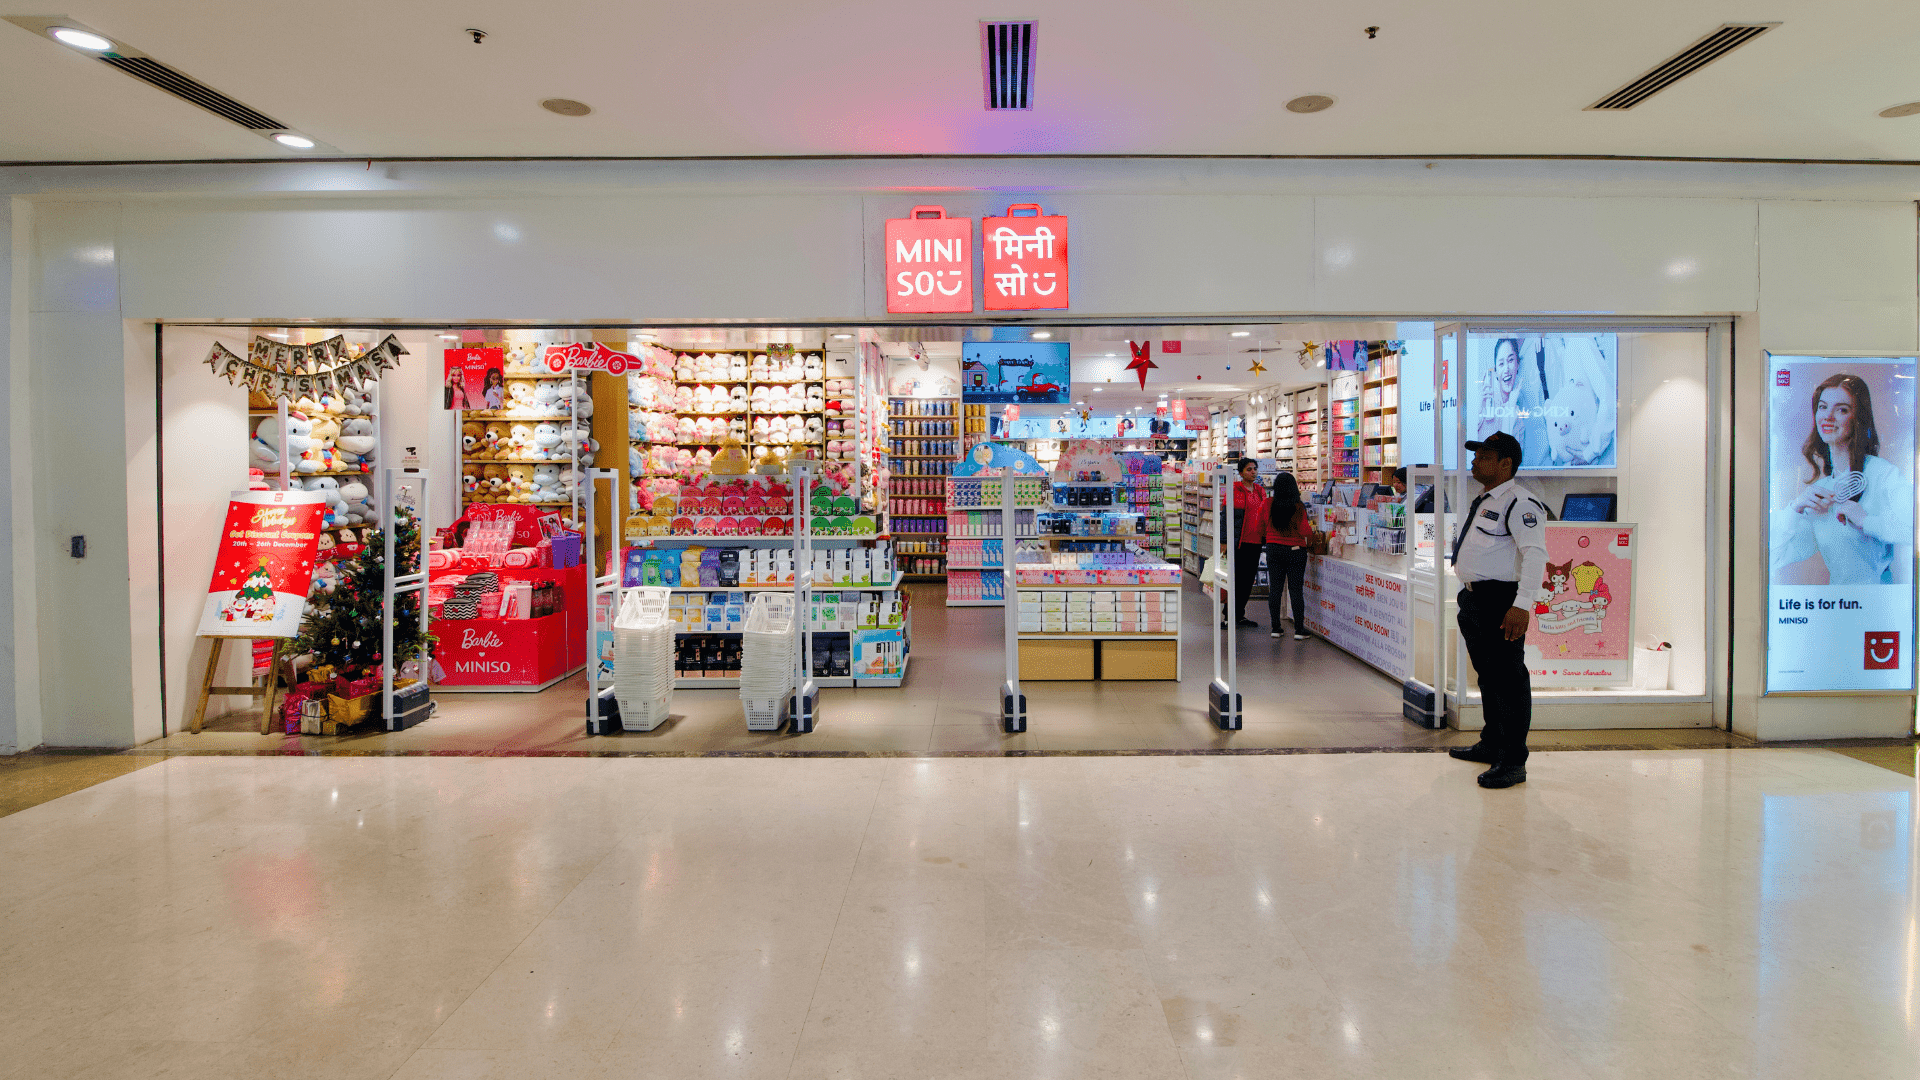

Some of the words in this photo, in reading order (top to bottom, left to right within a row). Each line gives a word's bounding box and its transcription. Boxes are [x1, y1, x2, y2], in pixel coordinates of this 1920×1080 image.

[896, 238, 962, 263] MINI
[992, 226, 1056, 260] मिनी
[993, 263, 1028, 297] सो
[255, 341, 342, 366] MERRY
[567, 343, 606, 368] Barbie
[226, 351, 385, 393] CHRISTMAS
[1419, 400, 1431, 412] Life
[494, 508, 524, 522] Barbie
[245, 530, 280, 539] Discount
[281, 531, 315, 541] Coupons
[1365, 574, 1374, 585] SEE
[1374, 577, 1385, 588] YOU
[1779, 598, 1801, 610] Life
[1804, 598, 1815, 610] is
[1818, 598, 1836, 610] for
[1838, 598, 1863, 610] fun.
[1363, 619, 1374, 631] YOU
[1373, 623, 1390, 638] SOON!
[1778, 617, 1808, 625] MINISO
[461, 628, 504, 650] Barbie
[455, 661, 511, 673] MINISO
